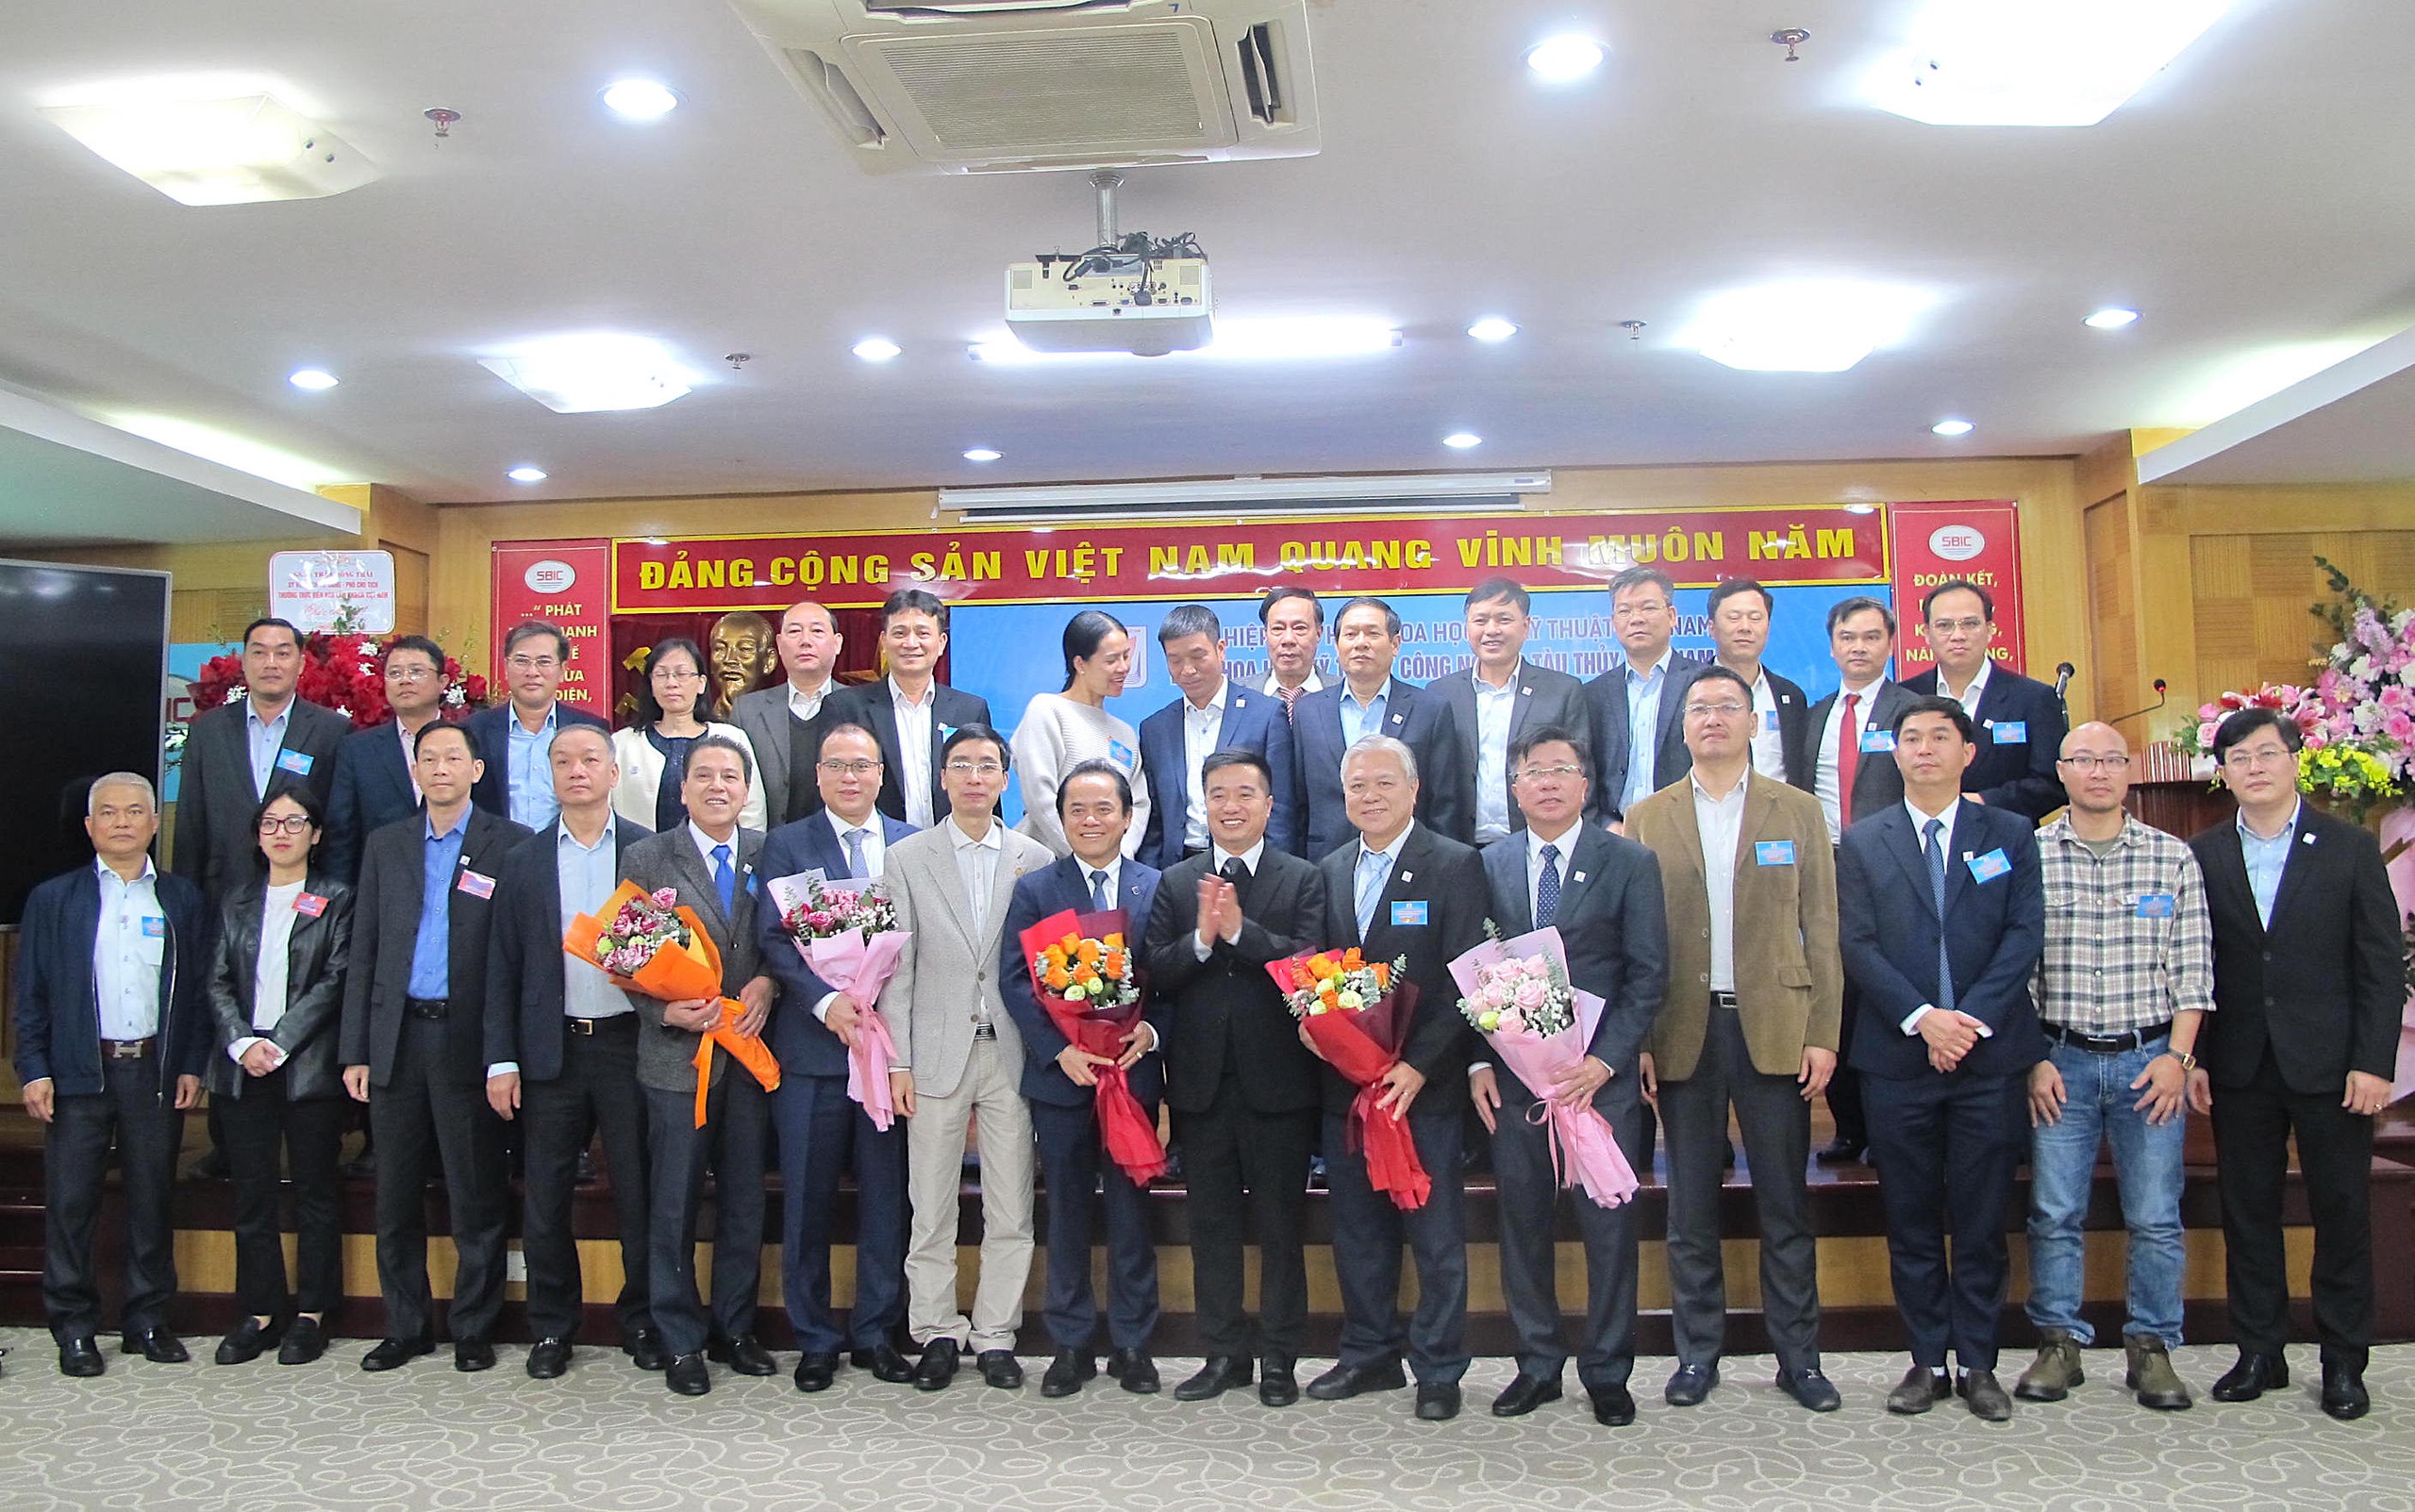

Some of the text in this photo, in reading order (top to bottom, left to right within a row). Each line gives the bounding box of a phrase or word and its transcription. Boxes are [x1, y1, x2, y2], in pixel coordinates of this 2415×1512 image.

[1941, 536, 1972, 547] SBIC
[640, 550, 754, 589] ĐẢNG
[770, 550, 889, 590] CỘNG
[909, 541, 1002, 582] SẢN
[1024, 540, 1124, 583] VIỆT
[1150, 543, 1255, 574] NAM
[1279, 540, 1431, 573] QUANG
[1588, 526, 1722, 565] MUÔN
[1748, 524, 1853, 559] NĂM
[536, 571, 563, 581] SBIC
[1966, 570, 1998, 587] KẾT,
[545, 601, 582, 616] PHÁT
[561, 625, 597, 640] ẠNH
[1401, 623, 1426, 642] OA
[1547, 616, 1611, 642] THUẬT
[1671, 616, 1710, 636] NAM
[1400, 652, 1451, 678] CÔNG
